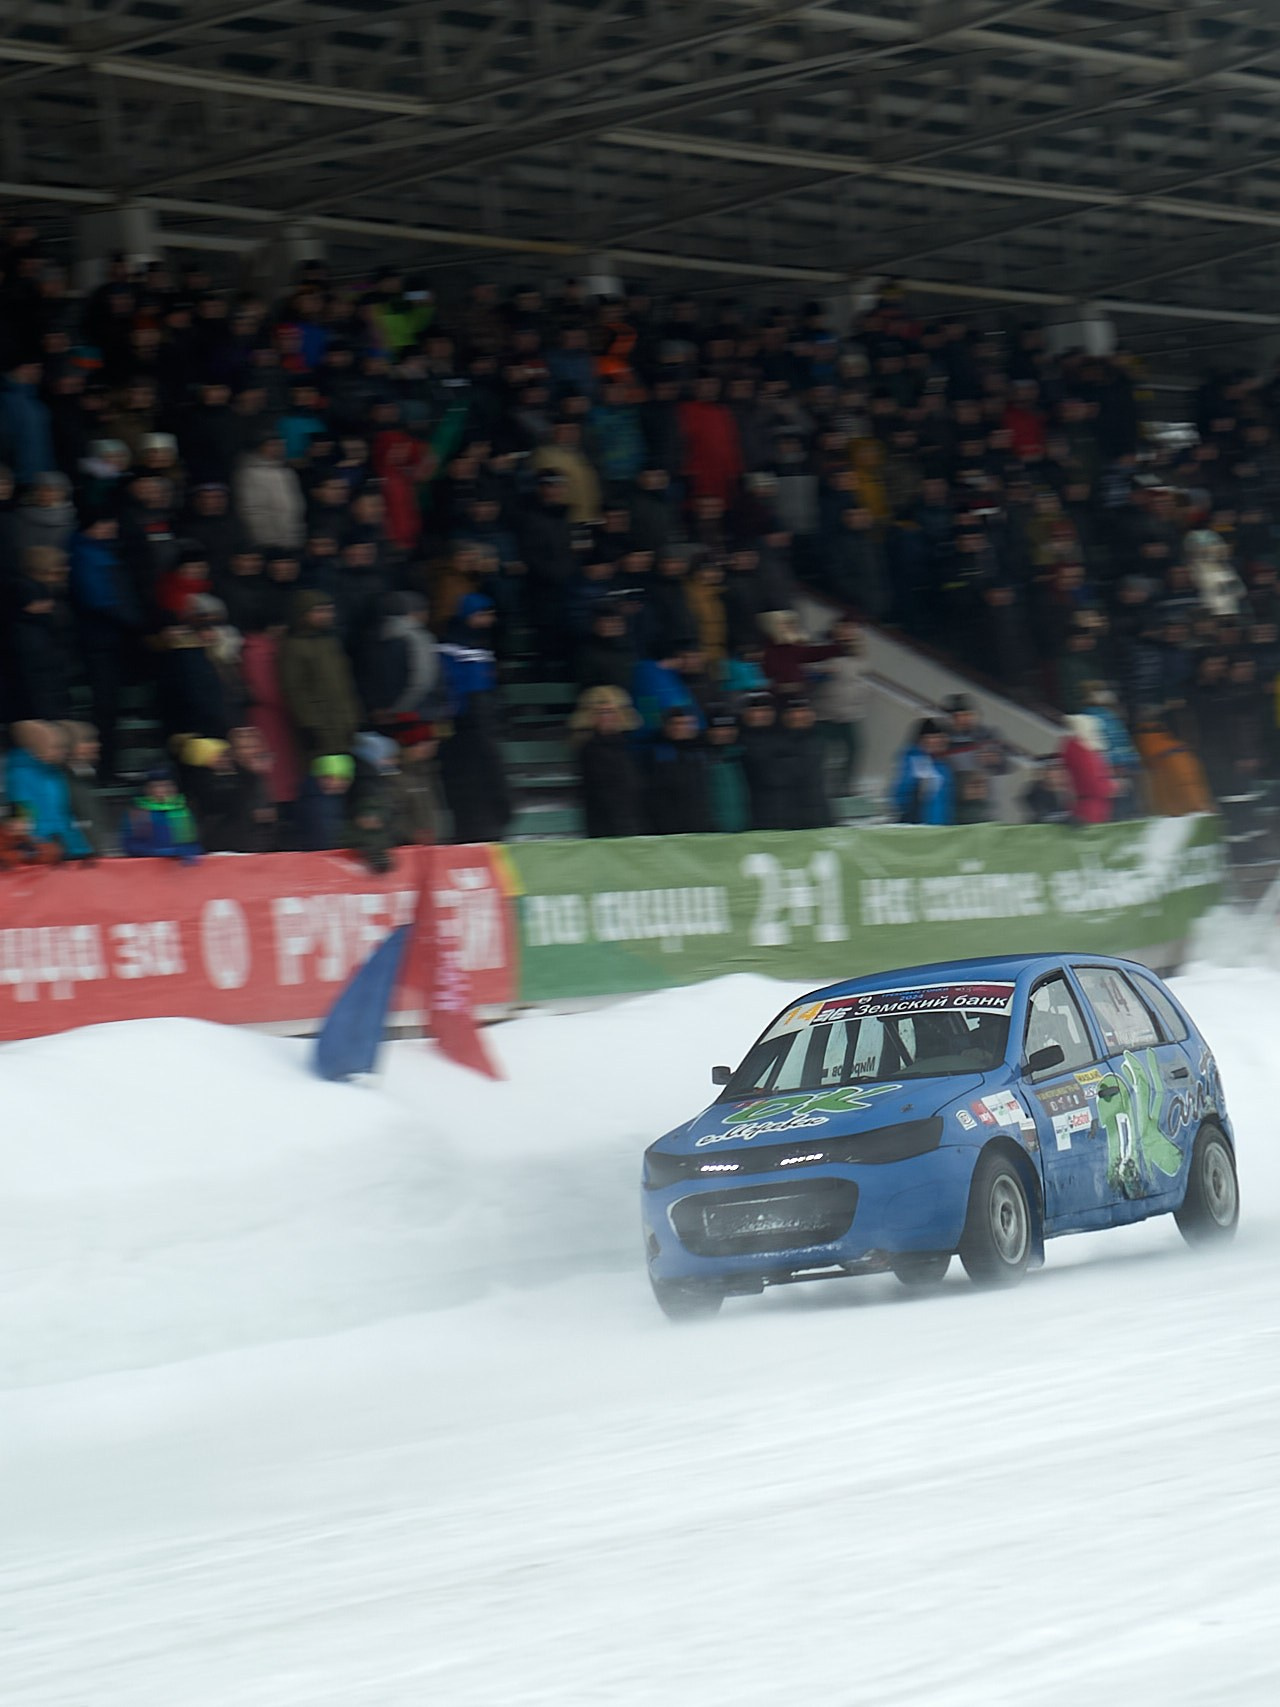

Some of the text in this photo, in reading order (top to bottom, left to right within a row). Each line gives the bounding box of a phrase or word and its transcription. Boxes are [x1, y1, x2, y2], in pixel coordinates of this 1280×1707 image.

[108, 920, 187, 979] за
[271, 866, 507, 986] РУБЕЙ
[740, 850, 849, 947] 2+1
[859, 877, 919, 926] на
[919, 857, 1047, 922] сайте
[783, 1001, 824, 1025] 14
[854, 995, 949, 1016] Земский
[953, 994, 1009, 1007] банк
